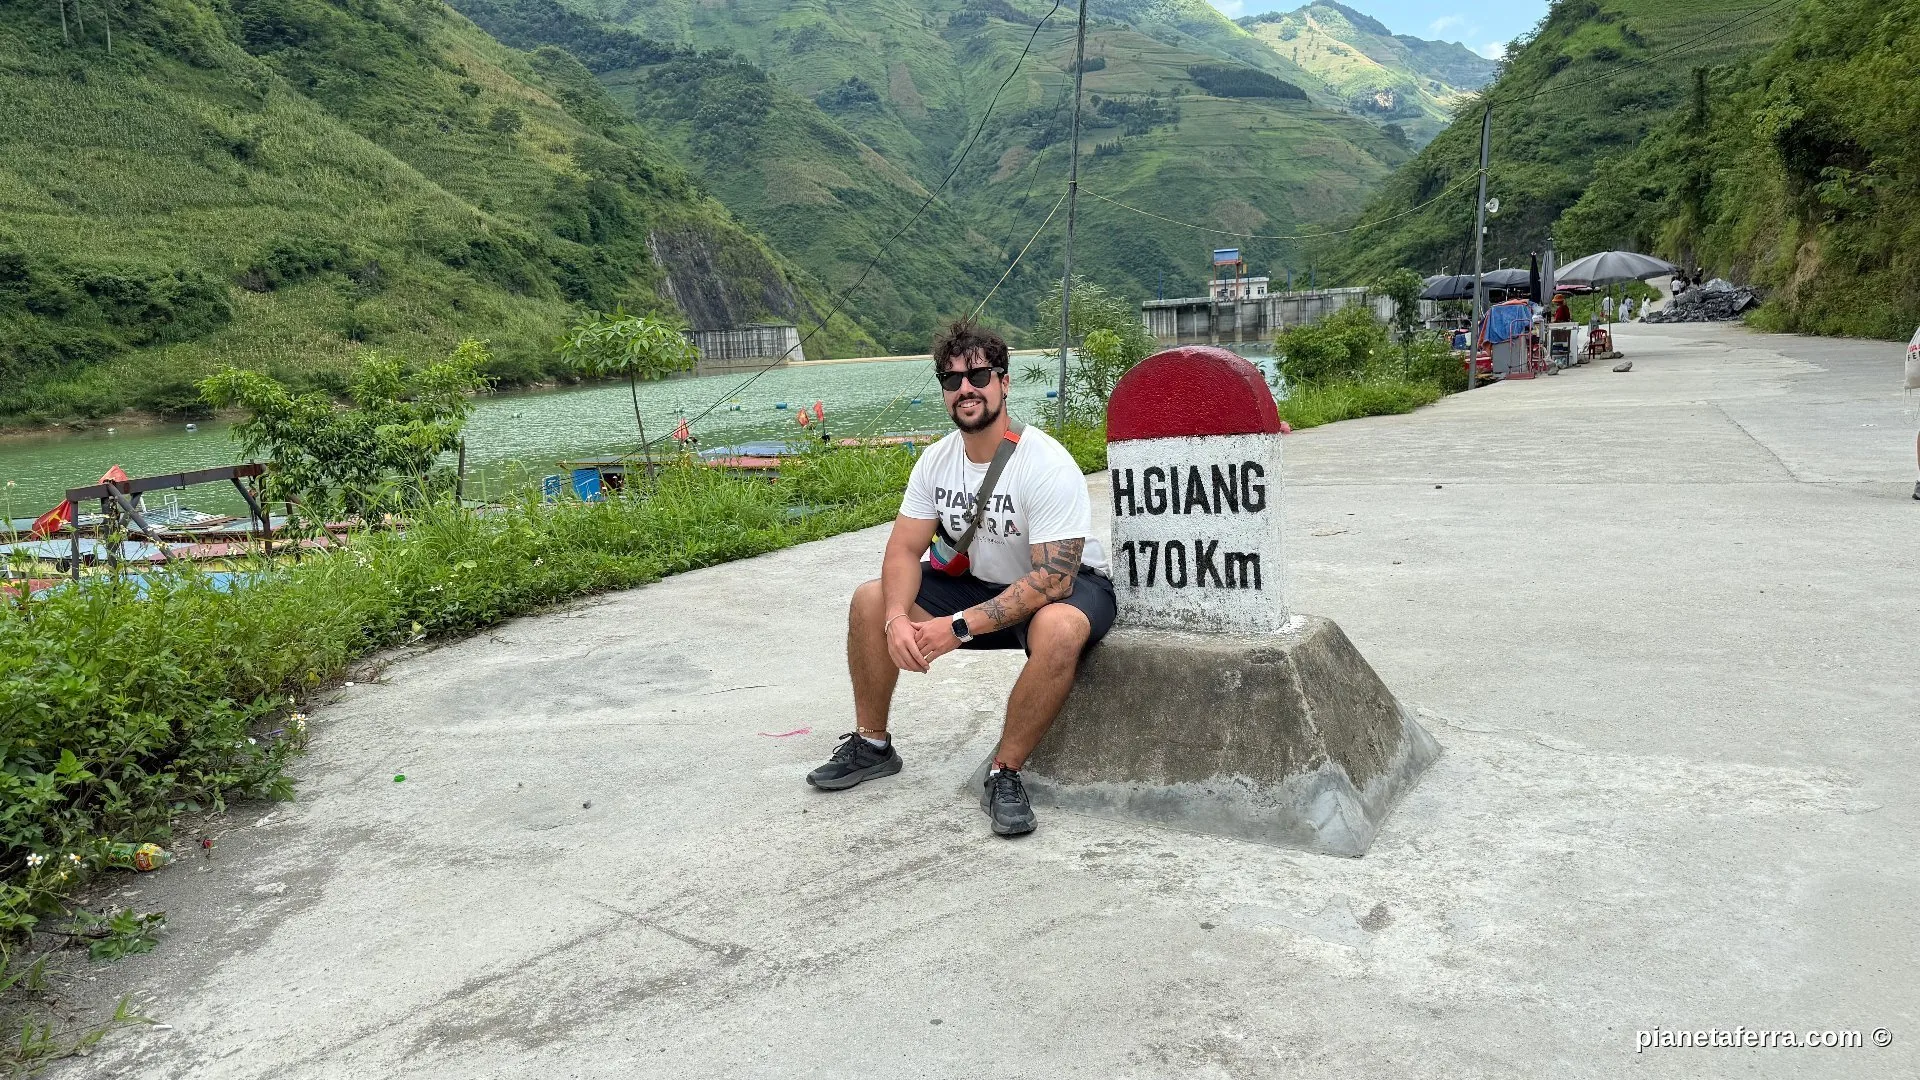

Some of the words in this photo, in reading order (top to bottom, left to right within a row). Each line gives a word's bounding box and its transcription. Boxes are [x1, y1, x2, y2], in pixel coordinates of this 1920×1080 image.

[1112, 461, 1266, 516] H.GIANG
[936, 509, 1021, 537] ERA
[1122, 540, 1187, 588] 170
[1195, 540, 1262, 590] Km
